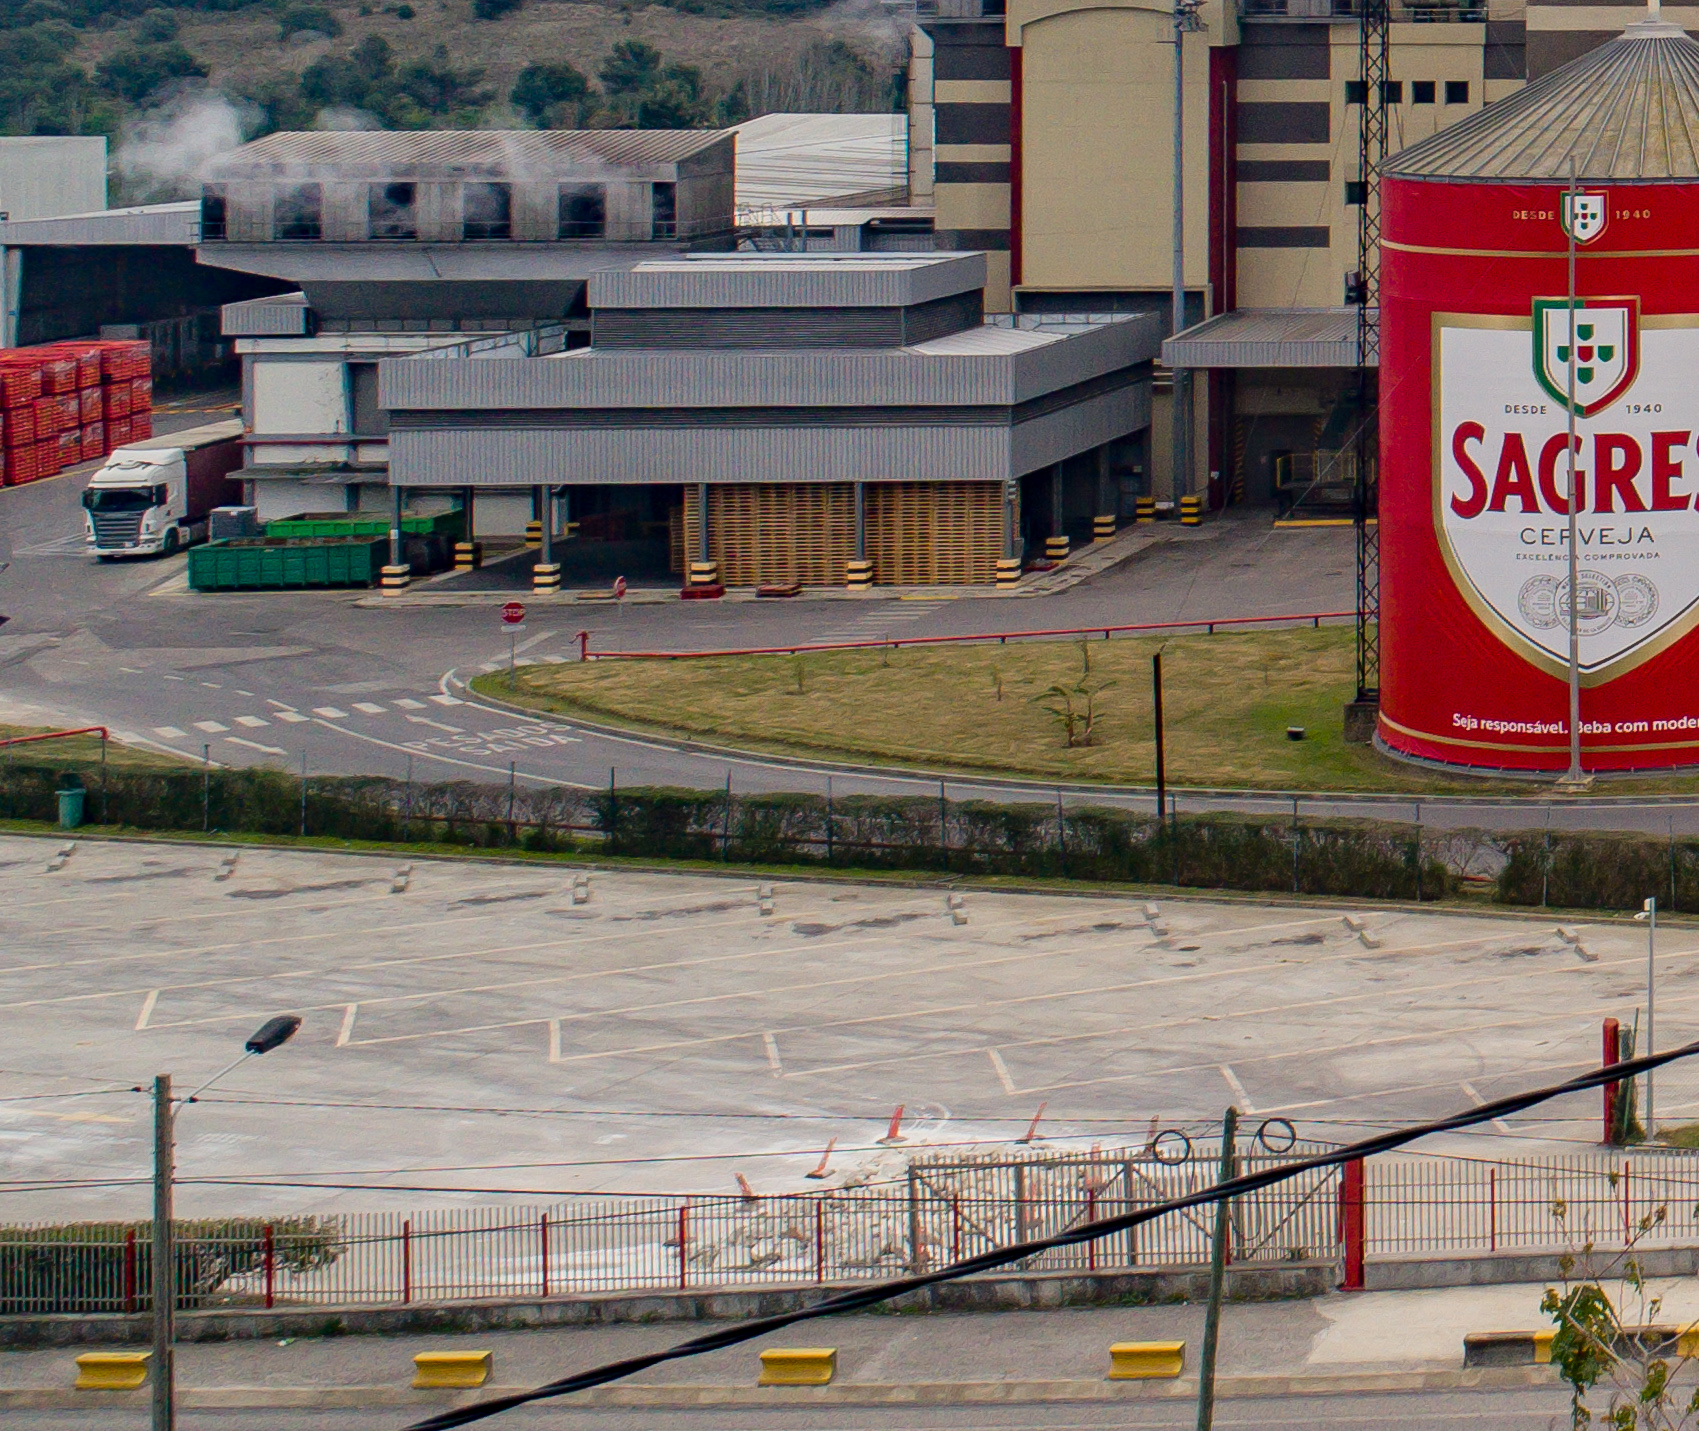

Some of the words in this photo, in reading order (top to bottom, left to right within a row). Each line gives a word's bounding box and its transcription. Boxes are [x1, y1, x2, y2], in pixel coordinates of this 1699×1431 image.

[1512, 210, 1555, 220] DESDE
[1615, 209, 1651, 220] 1940
[1504, 403, 1548, 416] DESDE
[1625, 402, 1663, 415] 1940
[1516, 552, 1580, 561] EXCELÊNC
[1584, 551, 1661, 561] COMPROVADA
[1452, 712, 1478, 730] Seja
[1480, 718, 1569, 734] responsável.
[1614, 719, 1649, 733] com
